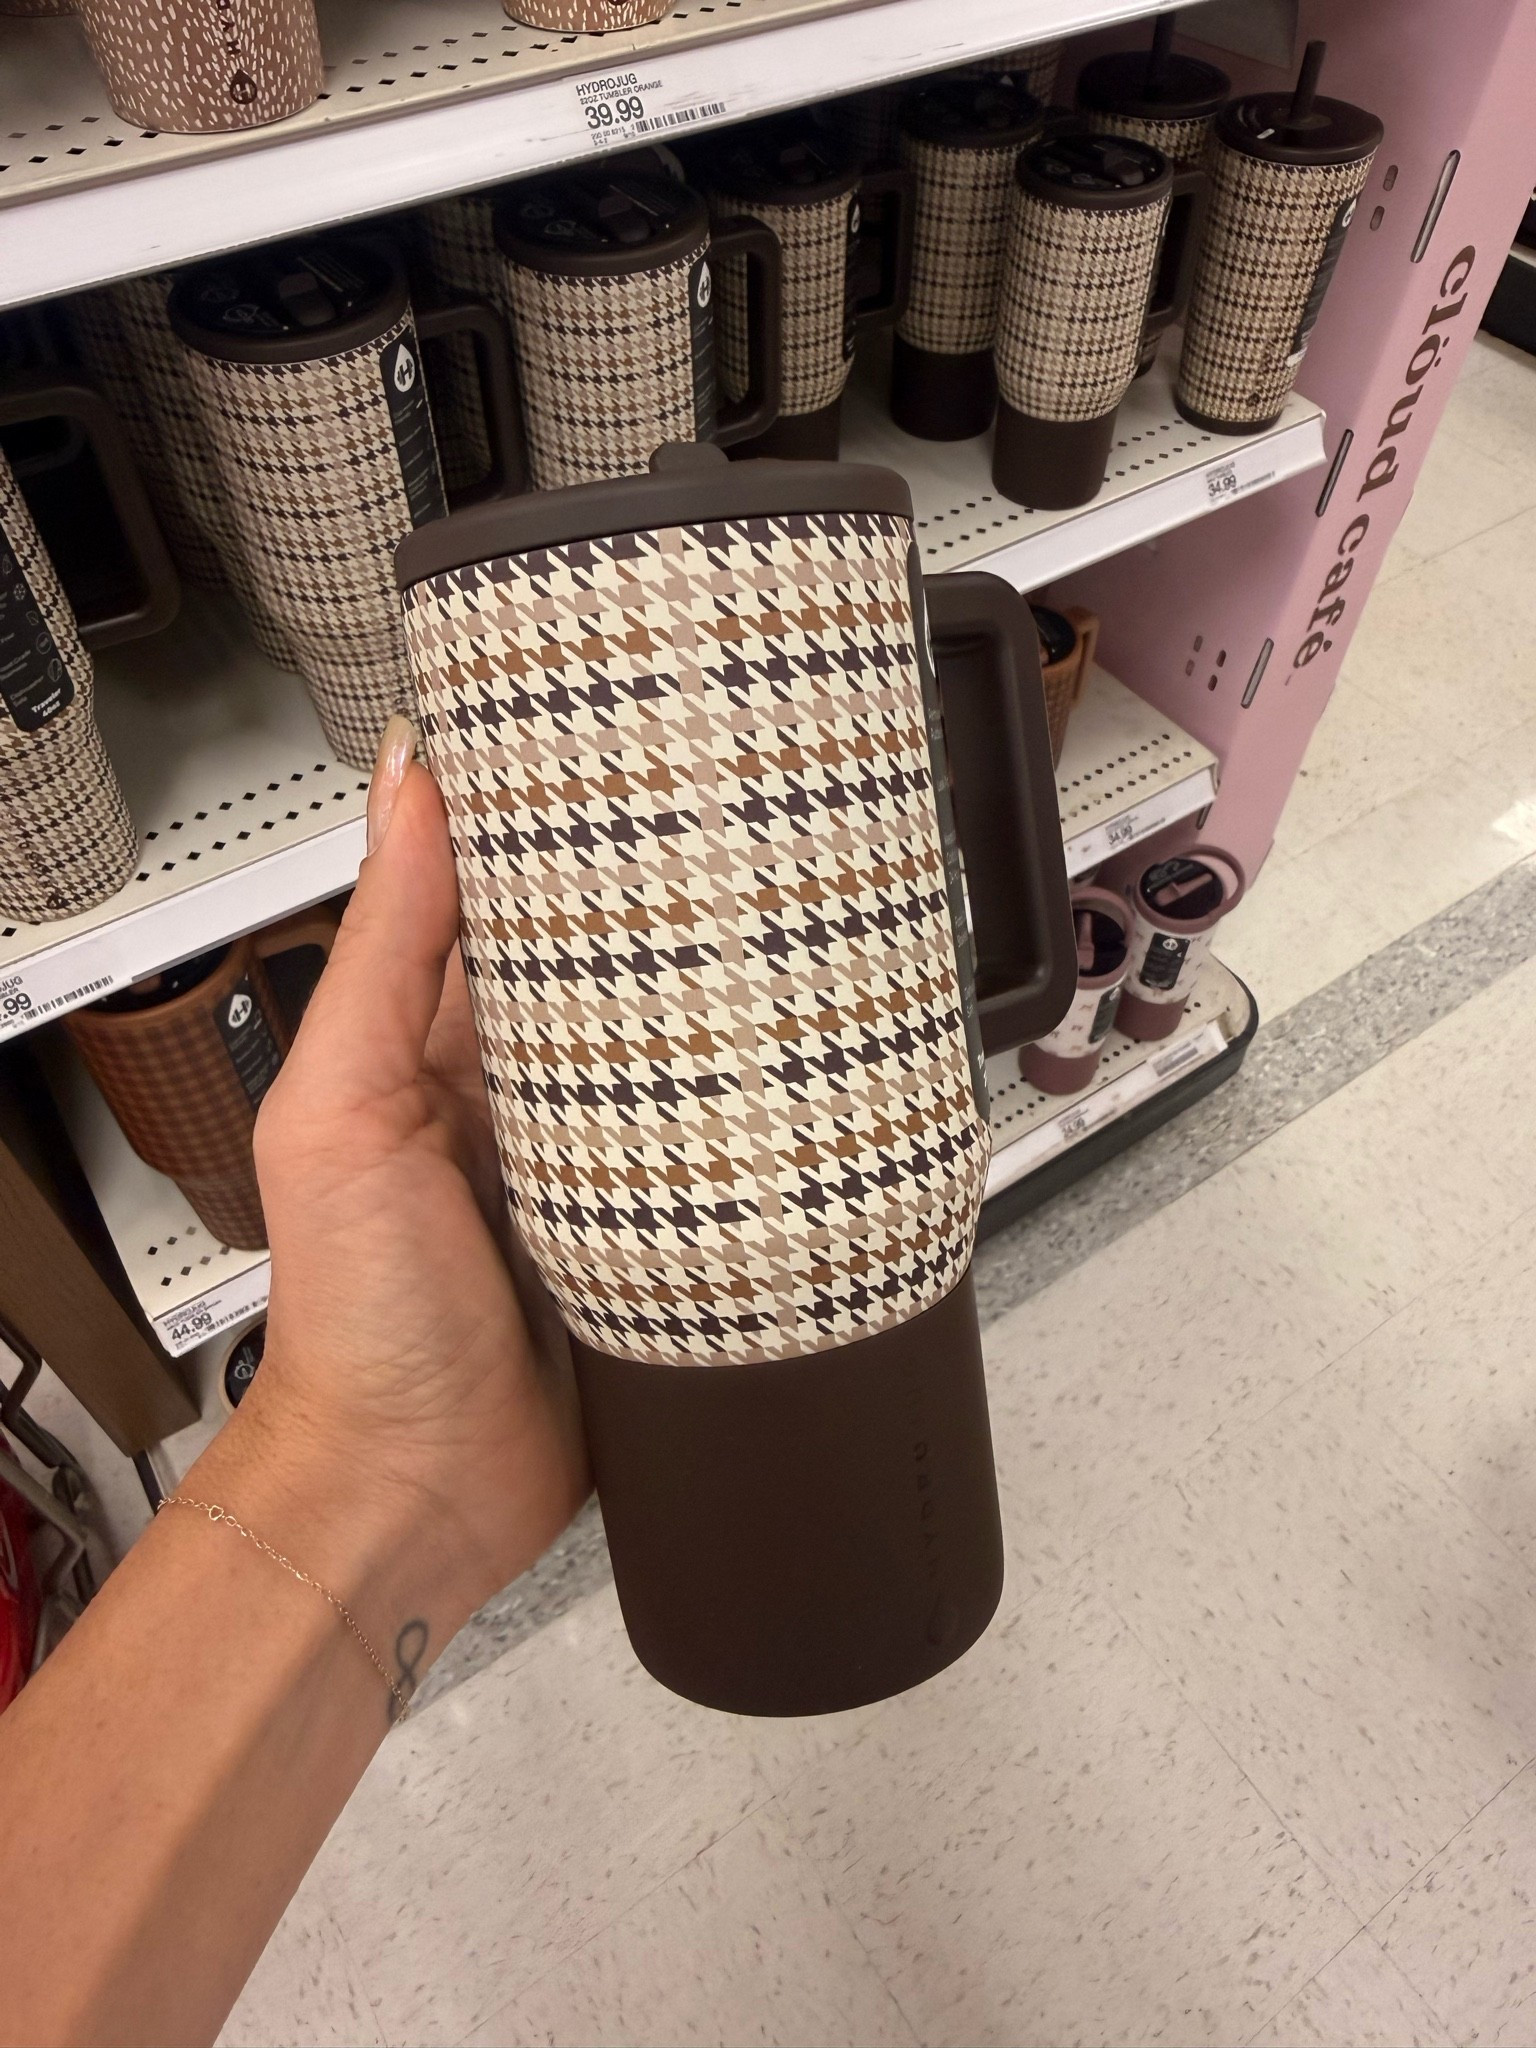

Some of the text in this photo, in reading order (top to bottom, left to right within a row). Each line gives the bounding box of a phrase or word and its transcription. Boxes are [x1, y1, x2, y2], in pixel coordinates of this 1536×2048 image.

[576, 73, 637, 96] HYDROJUG
[600, 89, 633, 100] TUMBLER
[634, 80, 663, 93] ORANGE
[585, 96, 644, 129] 39.99
[1292, 513, 1370, 669] café
[0, 975, 24, 992] JUG
[0, 992, 32, 1020] .99
[172, 1312, 212, 1341] 44.99
